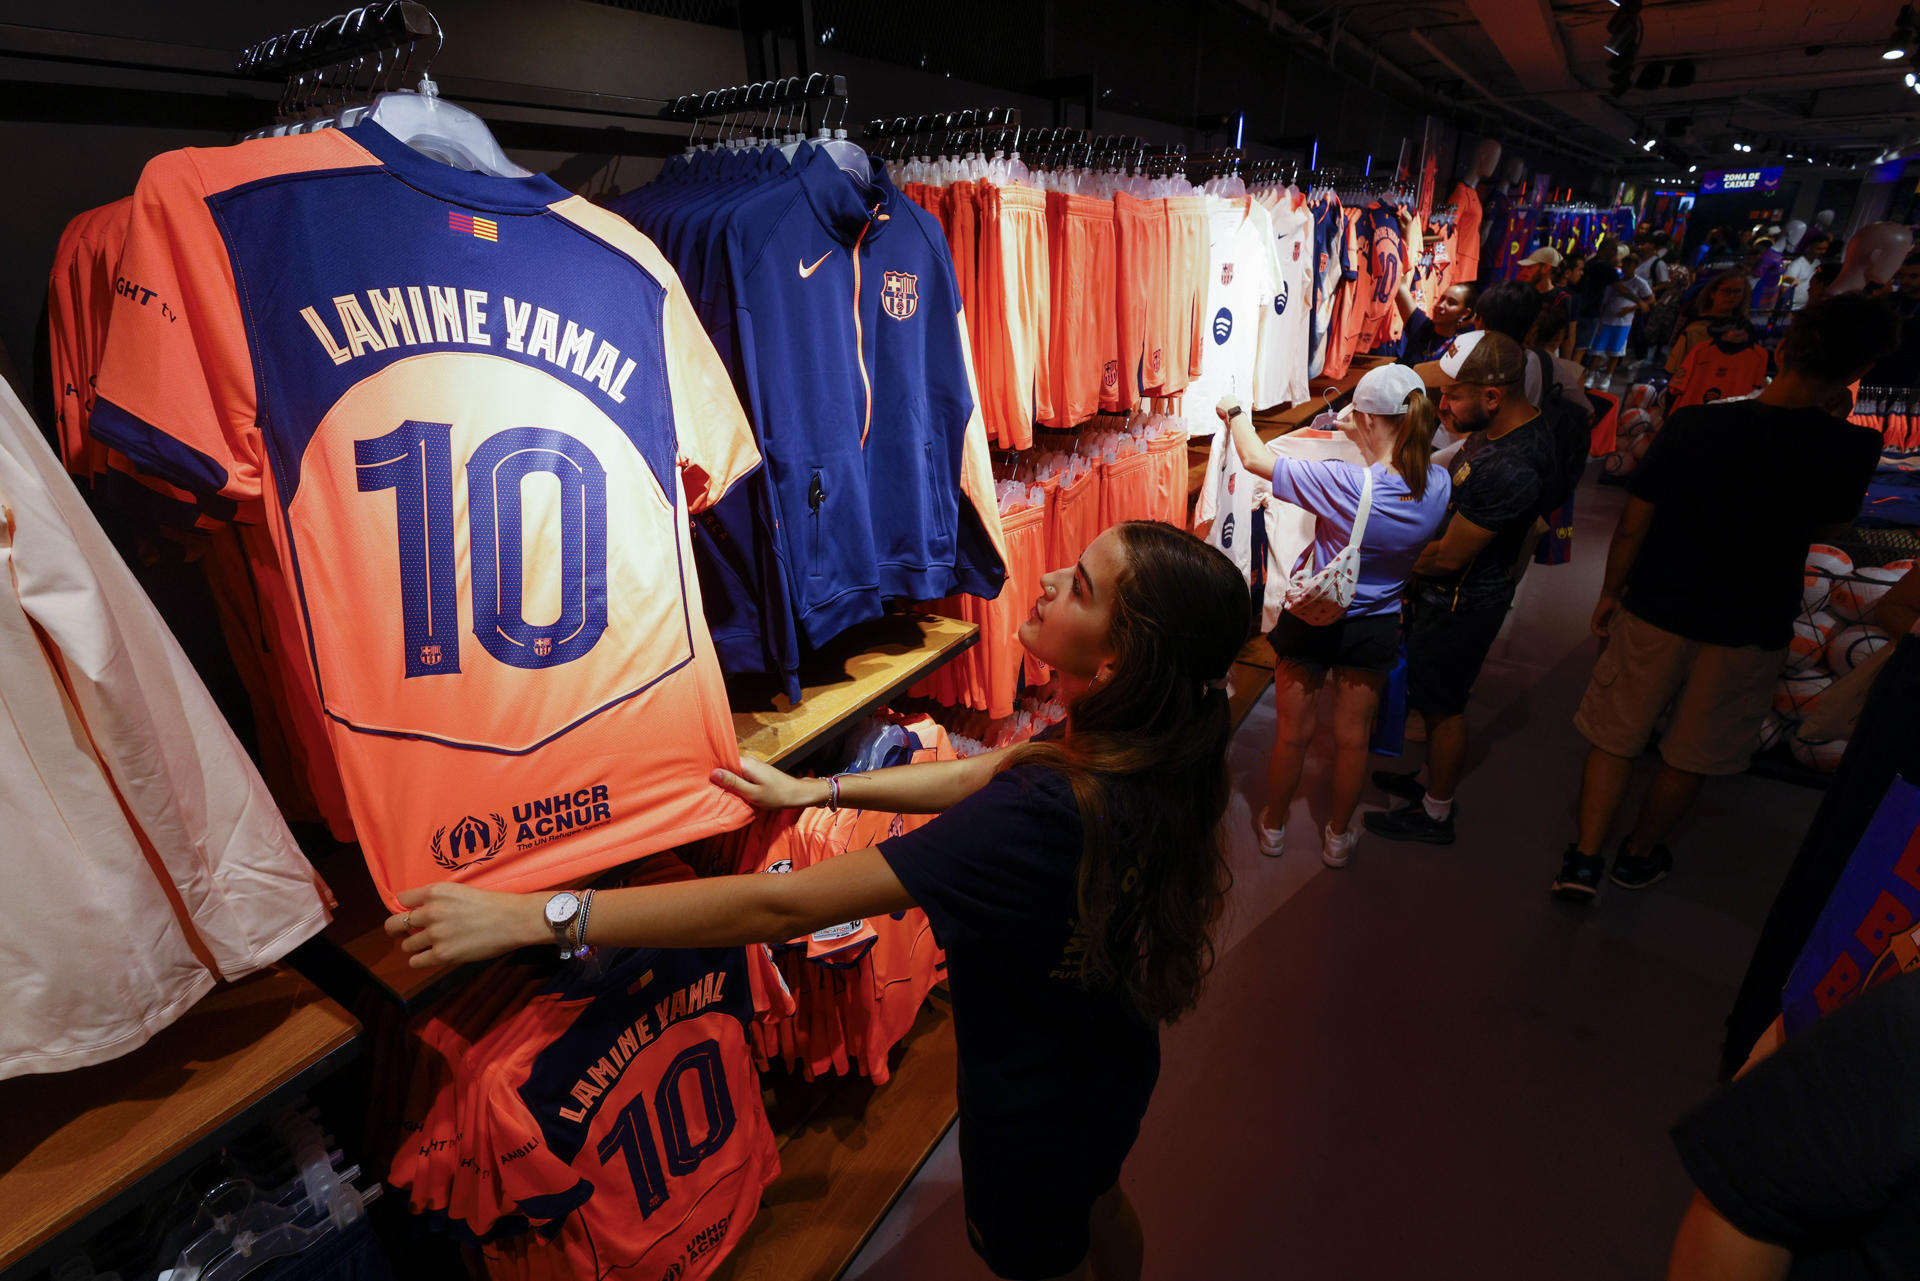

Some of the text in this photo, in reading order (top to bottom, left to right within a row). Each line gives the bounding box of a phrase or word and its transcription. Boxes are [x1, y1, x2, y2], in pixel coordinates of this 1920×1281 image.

[1723, 172, 1760, 181] ZONA DE
[1724, 180, 1755, 188] CAIXES
[1373, 252, 1398, 303] 10
[299, 285, 638, 404] LAMINE YAMAL
[354, 419, 609, 679] 10
[512, 784, 609, 824] UNHCR
[515, 802, 612, 843] ACNUR
[517, 842, 532, 851] The
[534, 838, 547, 846] UN
[548, 829, 581, 842] Refugee
[558, 971, 728, 1124] LAMINE YAMAL
[597, 1038, 737, 1222] 10
[687, 1210, 735, 1253] UNHC
